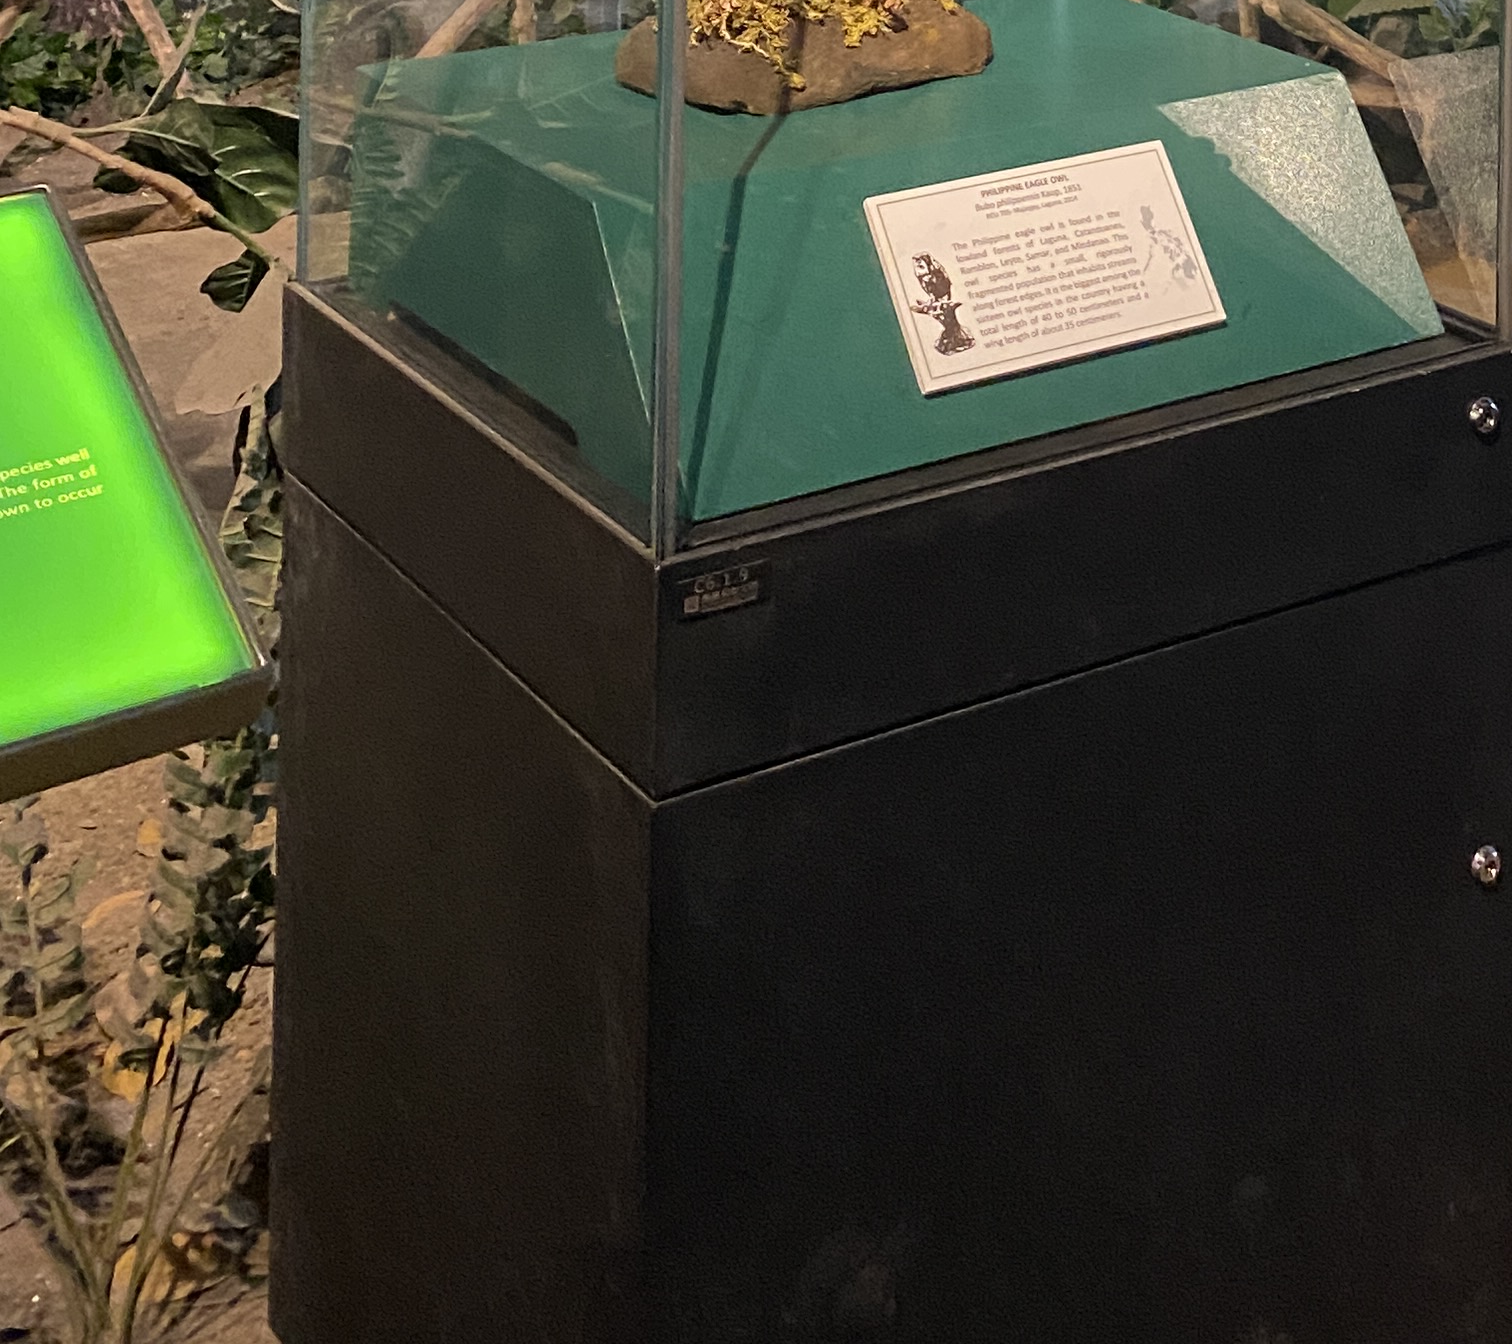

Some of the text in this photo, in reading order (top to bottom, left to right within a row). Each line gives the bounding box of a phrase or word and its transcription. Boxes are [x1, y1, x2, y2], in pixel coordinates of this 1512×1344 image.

[980, 174, 1069, 197] PHILIPPINE EAGLE OWL
[1064, 320, 1074, 329] 35
[0, 459, 53, 483] pecies
[32, 473, 75, 490] form
[79, 464, 97, 479] of
[34, 498, 53, 509] to
[57, 484, 104, 503] occur
